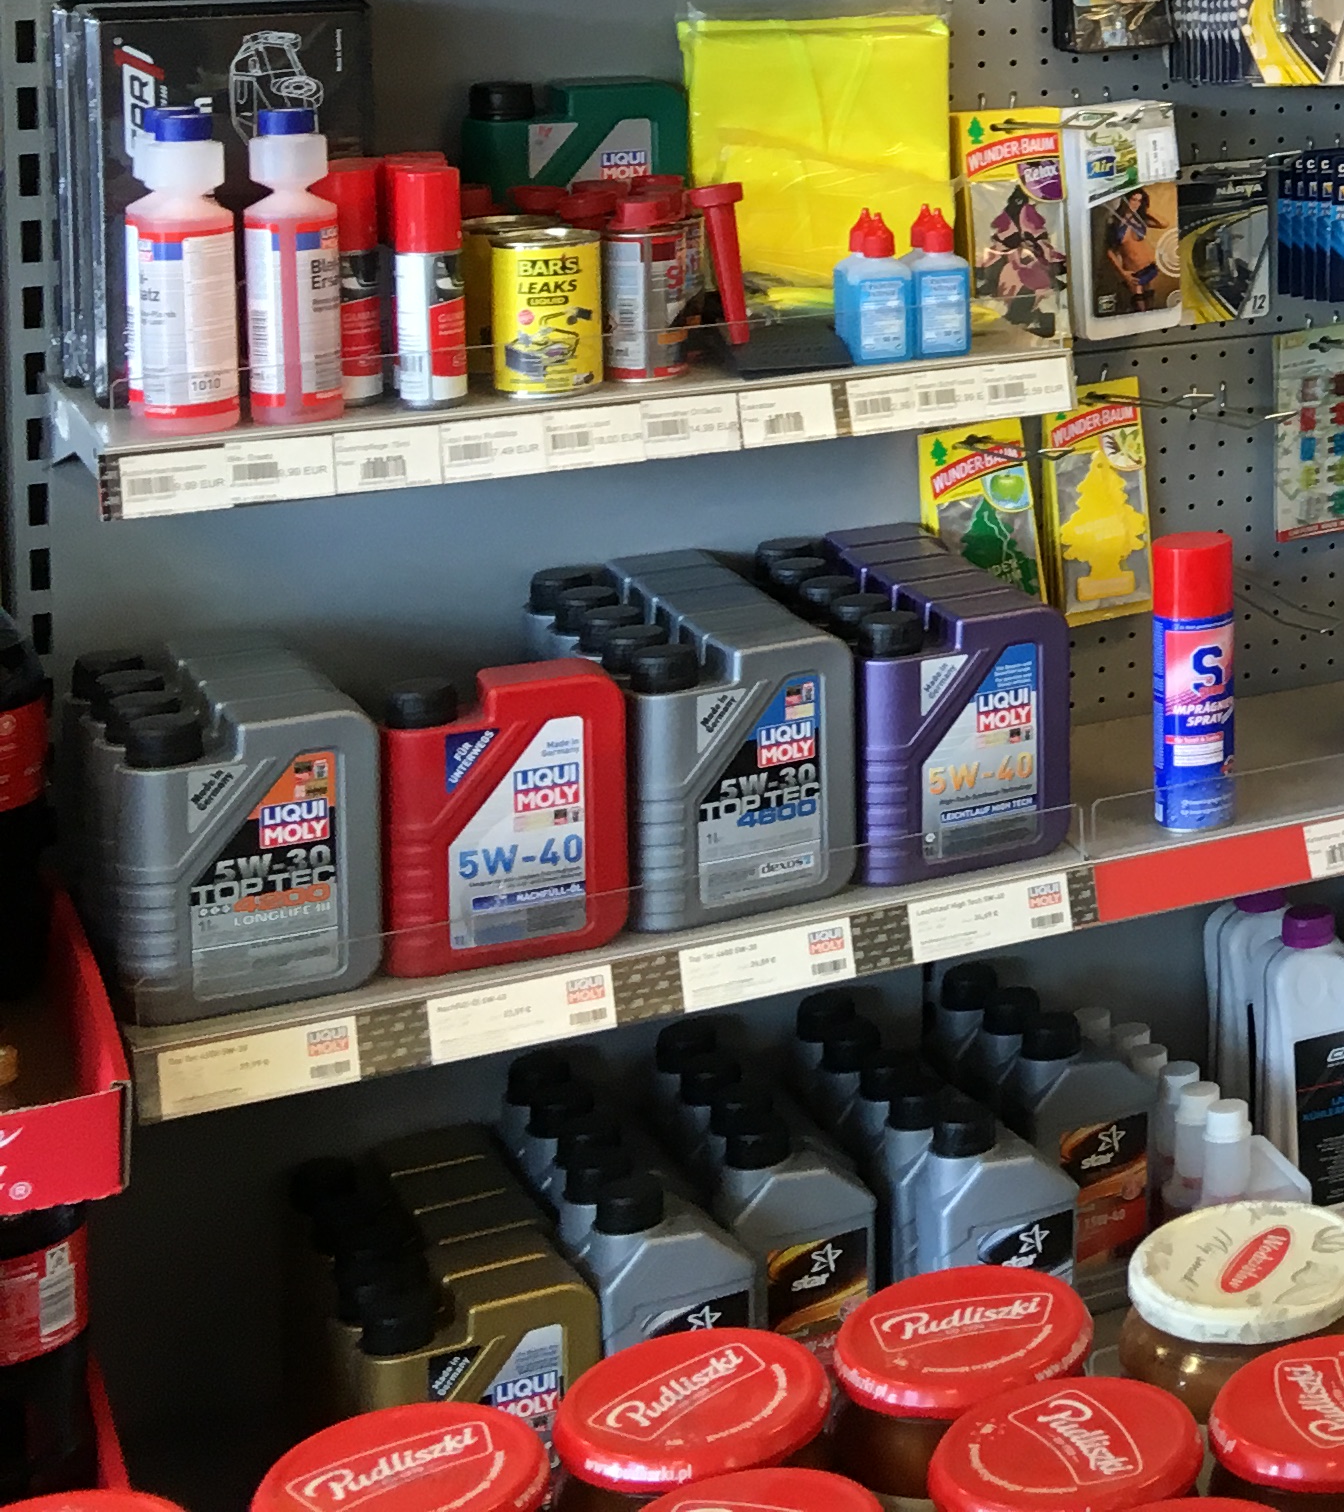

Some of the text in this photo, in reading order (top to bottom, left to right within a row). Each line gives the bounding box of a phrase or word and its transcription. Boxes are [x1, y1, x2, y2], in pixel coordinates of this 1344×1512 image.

[601, 150, 646, 166] LIQUI
[967, 138, 1058, 170] WUNDER-BAUM
[517, 280, 577, 295] LEAKS
[191, 377, 221, 392] 1010
[1052, 411, 1135, 446] WUNDER-BAUM
[516, 443, 539, 453] EUR
[978, 688, 1029, 711] LIQUI
[978, 707, 1032, 730] MOLY
[1187, 713, 1222, 725] SPRAY
[761, 723, 814, 744] LIQUI
[760, 741, 815, 765] MOLY
[516, 766, 579, 788] LIQUI
[721, 766, 817, 800] 5W-30
[929, 751, 1035, 794] 5W-40
[517, 785, 581, 809] MOLY
[262, 803, 327, 824] LIQUI
[736, 801, 817, 828] 4600
[263, 821, 328, 845] MOLY
[215, 845, 330, 880] 5W-30
[459, 835, 583, 879] 5W-40
[1081, 1153, 1114, 1169] star
[794, 1274, 829, 1291] star
[884, 1297, 1042, 1341] Pudliszki
[494, 1372, 558, 1399] LIQUI
[606, 1350, 743, 1428] Pudliszki
[1037, 1398, 1133, 1476] Pudliszki
[303, 1428, 480, 1500] Pudliszki
